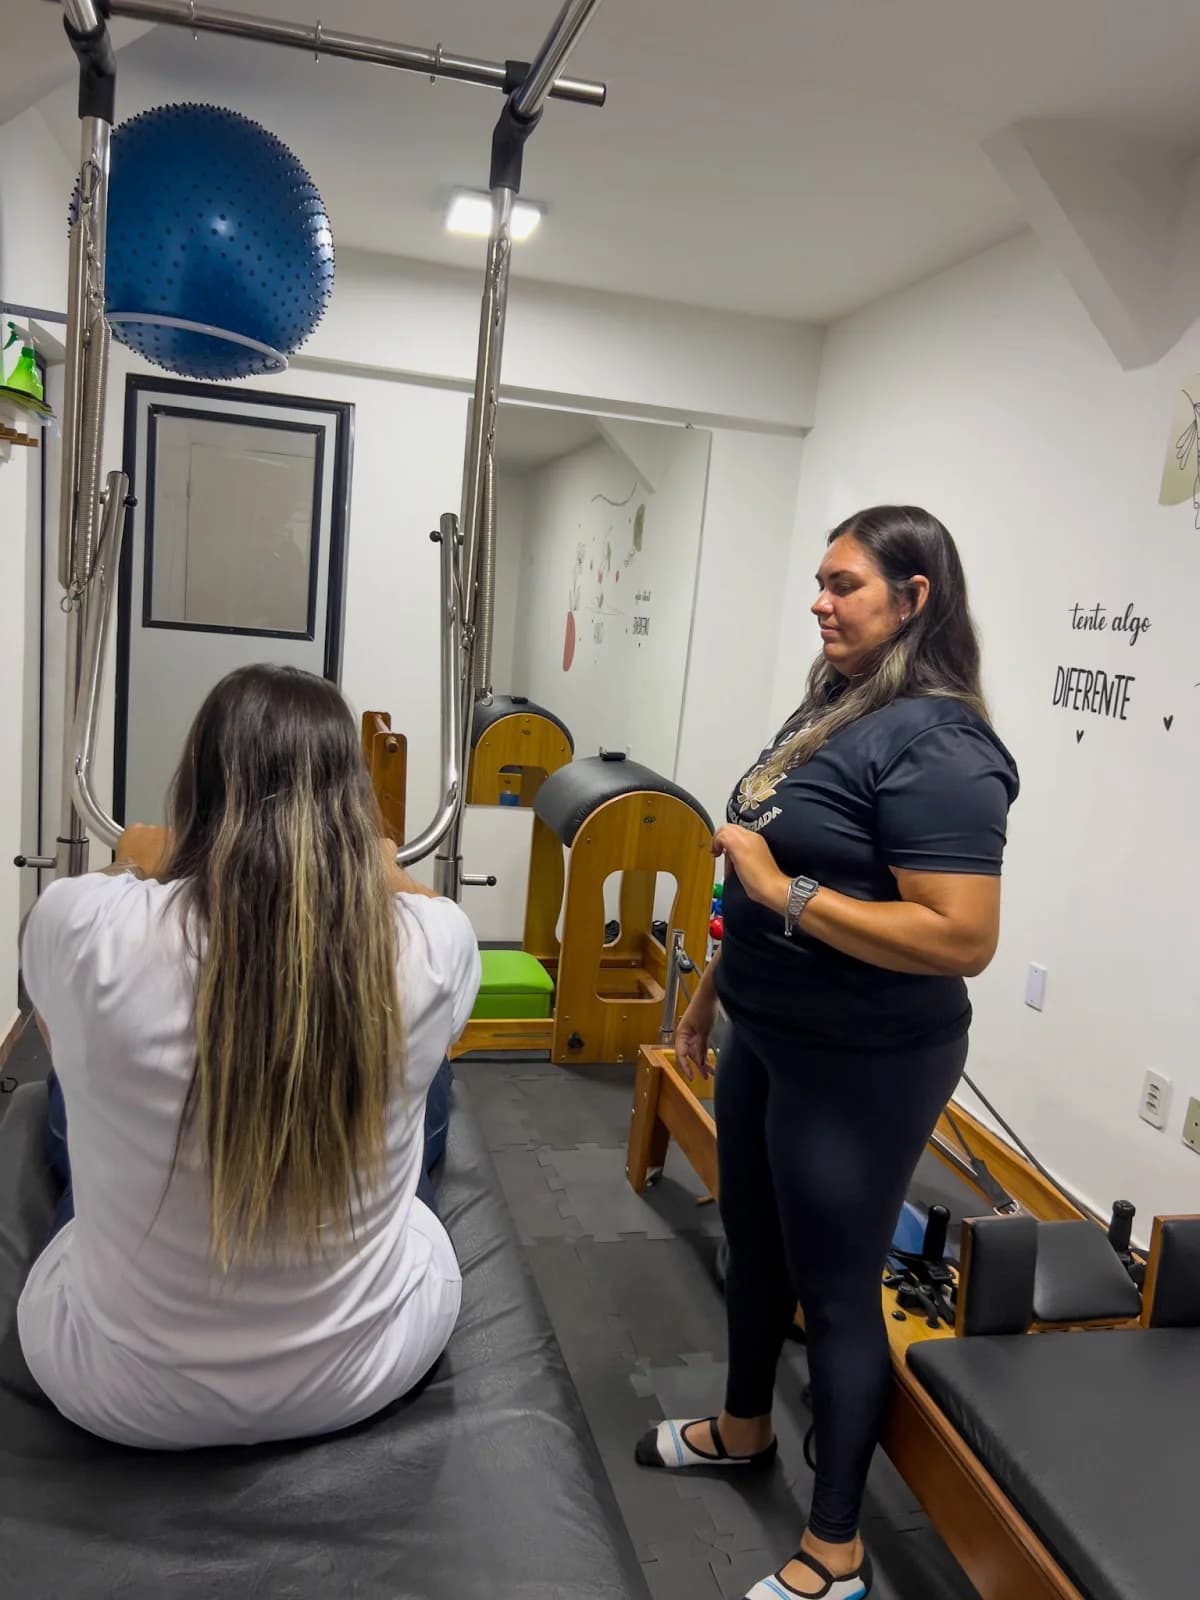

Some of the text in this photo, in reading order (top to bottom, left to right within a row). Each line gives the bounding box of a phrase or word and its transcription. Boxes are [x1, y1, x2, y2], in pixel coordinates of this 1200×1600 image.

[1068, 602, 1152, 646] tente algo
[1053, 665, 1136, 720] DIFERENTE
